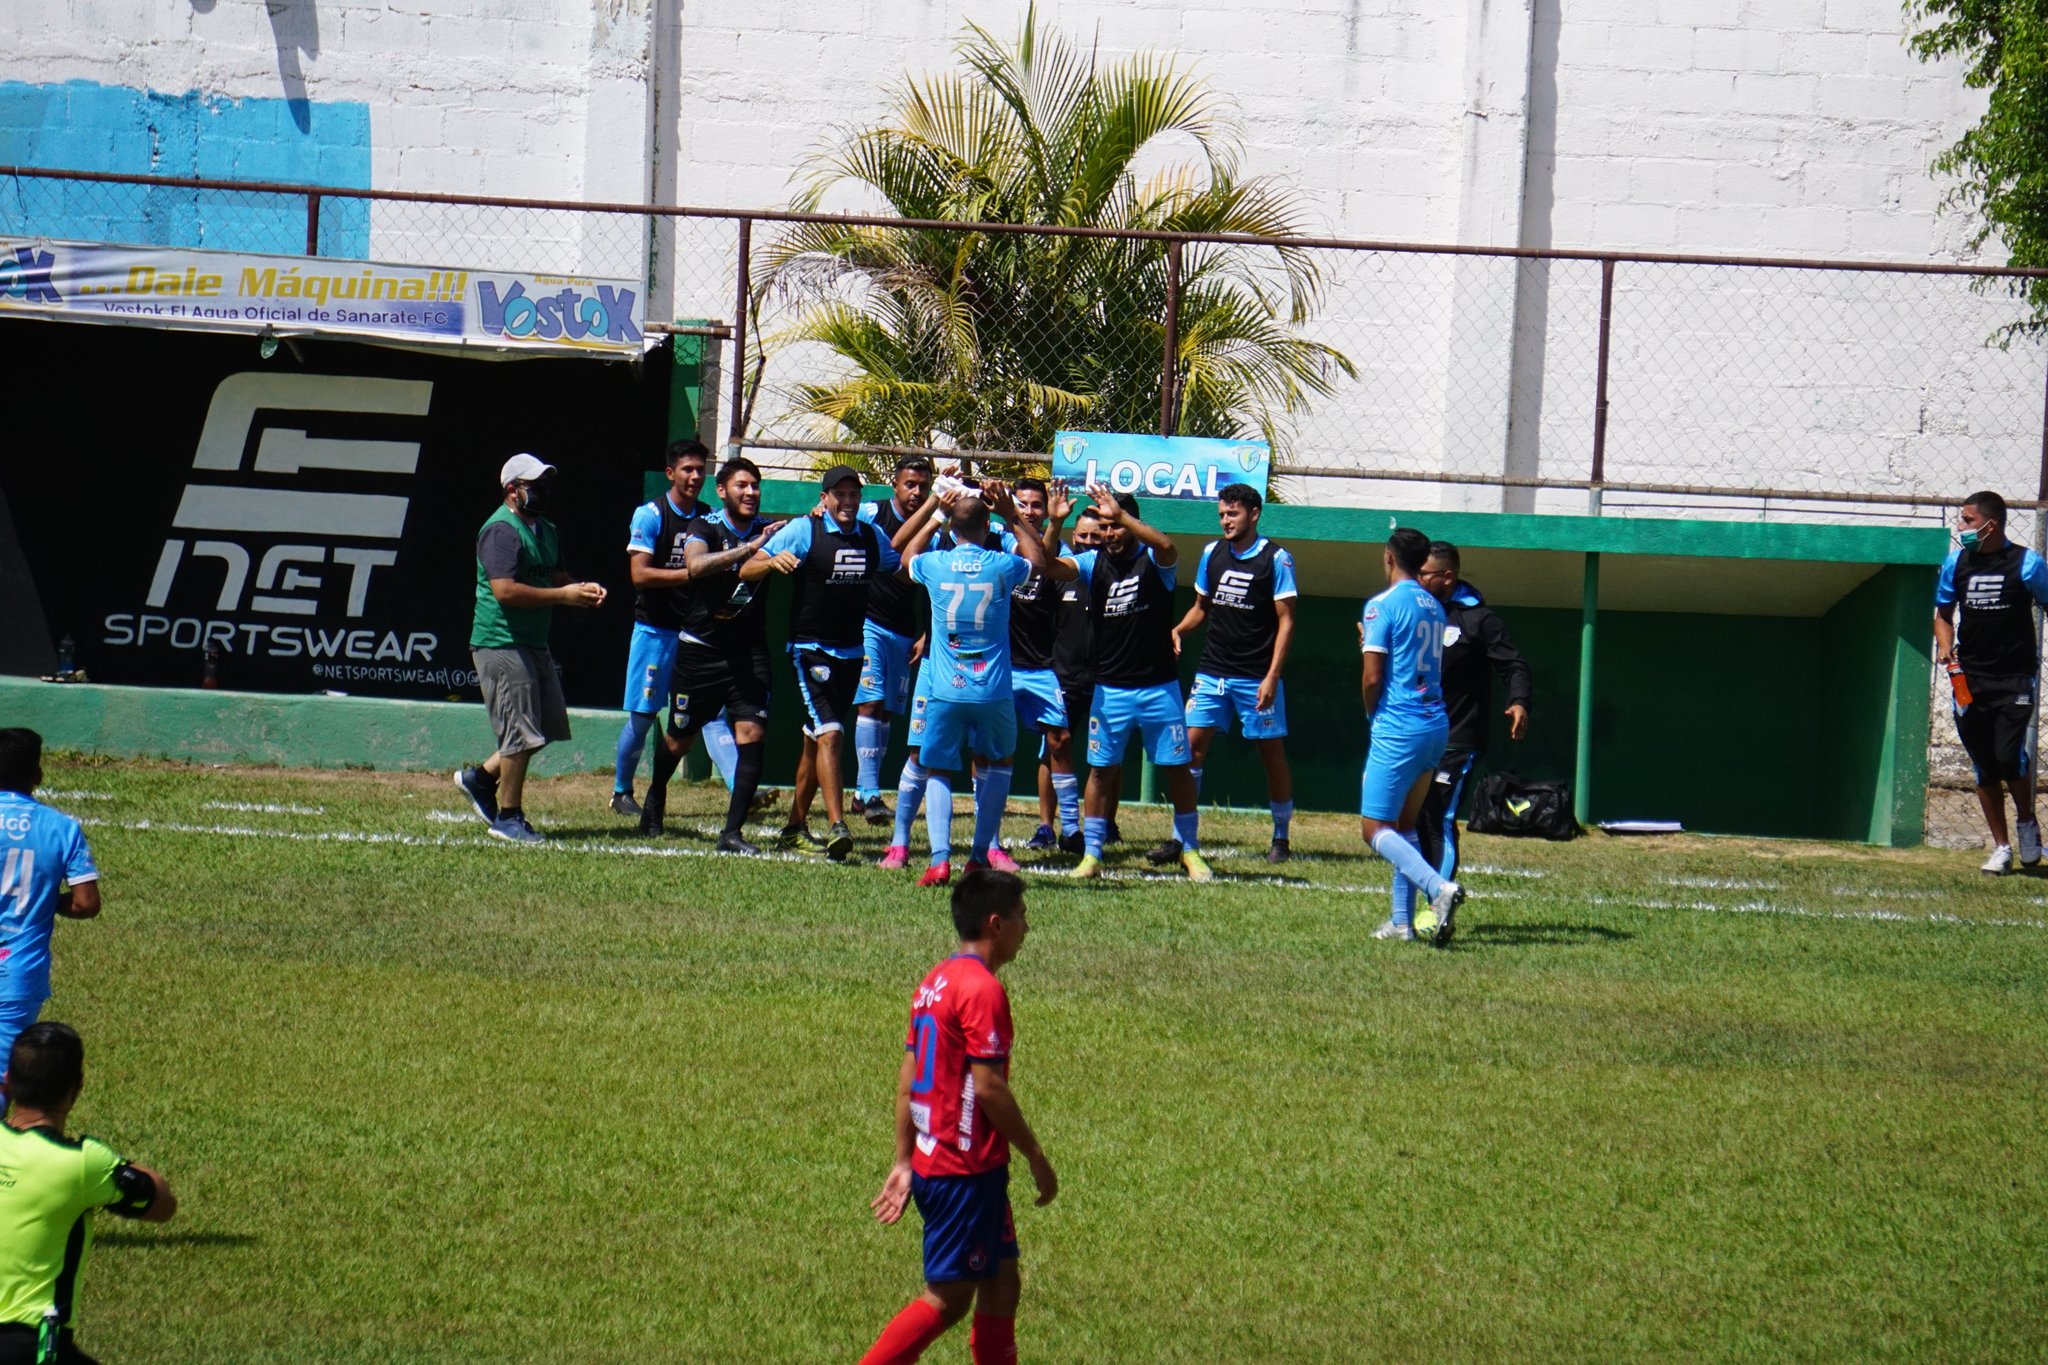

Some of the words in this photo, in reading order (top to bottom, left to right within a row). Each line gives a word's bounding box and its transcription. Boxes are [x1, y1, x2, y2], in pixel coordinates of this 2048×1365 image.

[238, 266, 468, 306] Máquina!!!
[567, 276, 593, 287] Pura
[245, 306, 301, 320] Oficial
[307, 308, 330, 322] de
[336, 309, 417, 324] Sanarate
[424, 312, 447, 325] FC
[940, 583, 993, 630] 77
[104, 614, 438, 662] SPORTSWEAR
[1417, 620, 1444, 672] 24
